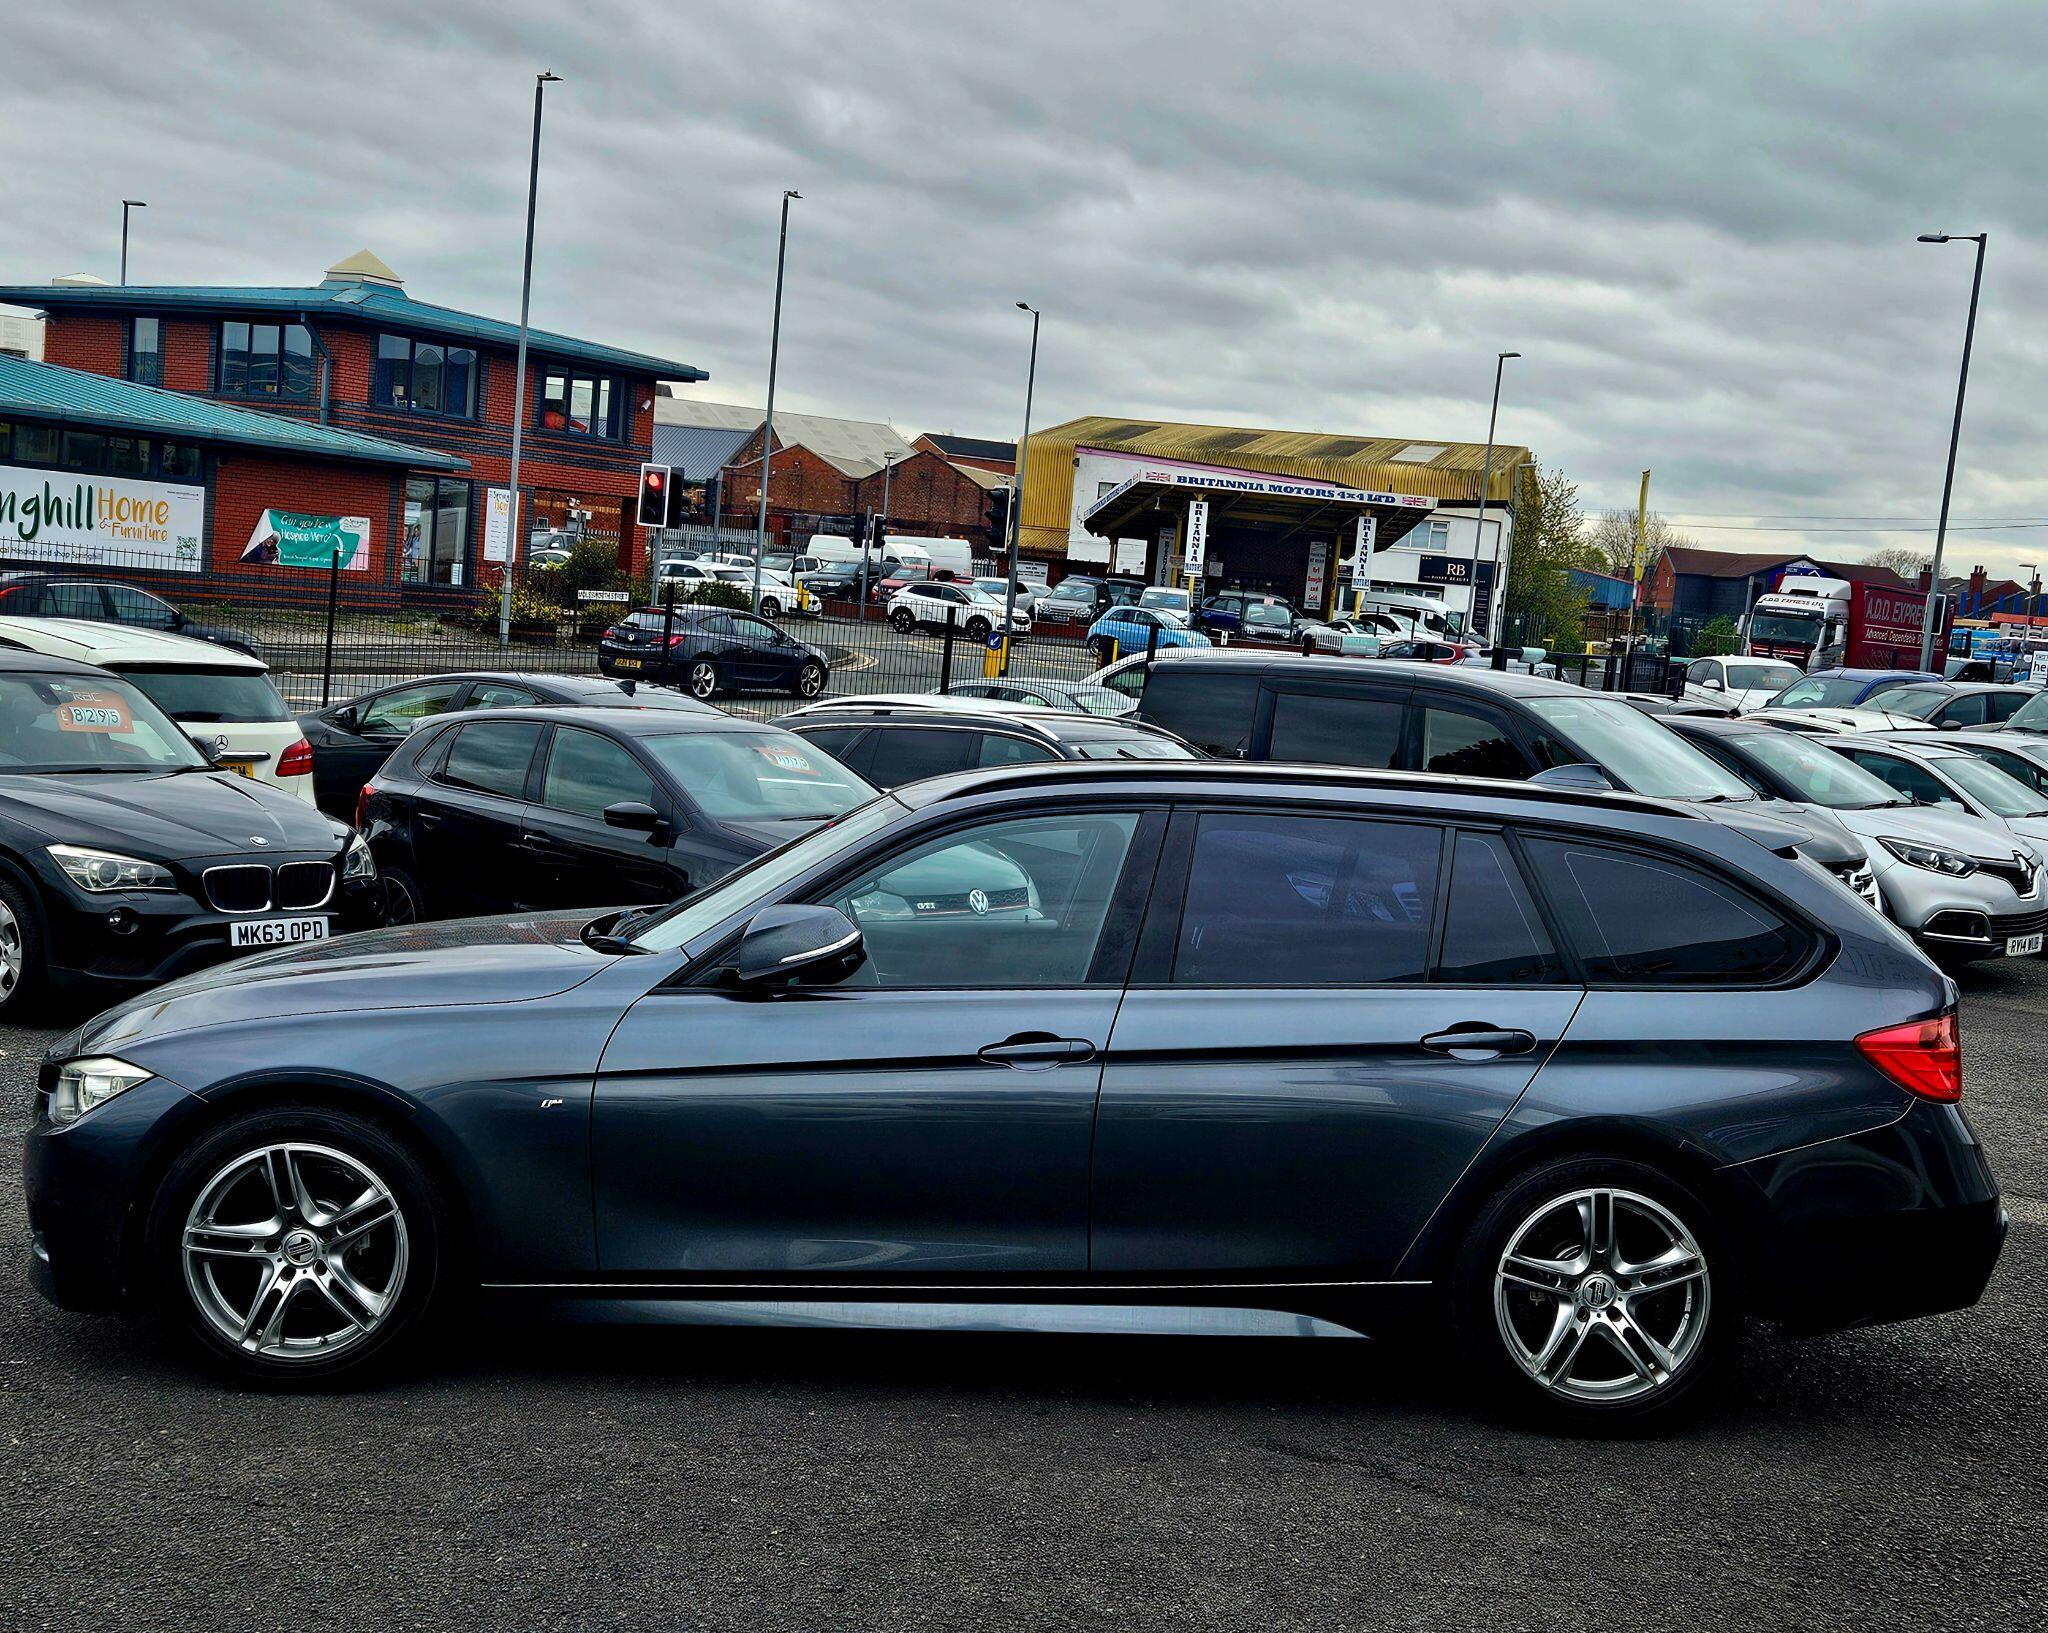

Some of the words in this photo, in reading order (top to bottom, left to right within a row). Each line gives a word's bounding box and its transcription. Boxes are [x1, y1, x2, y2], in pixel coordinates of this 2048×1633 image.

[1176, 475, 1264, 491] BRITANNIA
[1268, 484, 1335, 498] MOTORS
[1337, 491, 1364, 500] 4x4
[1367, 493, 1396, 504] LTD
[97, 487, 169, 525] Home
[111, 522, 168, 541] Furniture
[281, 515, 297, 525] Can
[297, 520, 313, 531] you
[1190, 503, 1204, 562] BRITANNIA
[281, 529, 309, 544] Hospice
[54, 549, 70, 559] shop
[1357, 518, 1372, 577] BRITANNIA
[1447, 563, 1466, 576] RB
[1892, 601, 1926, 626] EXPRES
[1865, 628, 1888, 641] Advanced
[74, 708, 119, 724] 8295
[237, 924, 285, 944] MK63
[290, 921, 323, 940] OPD
